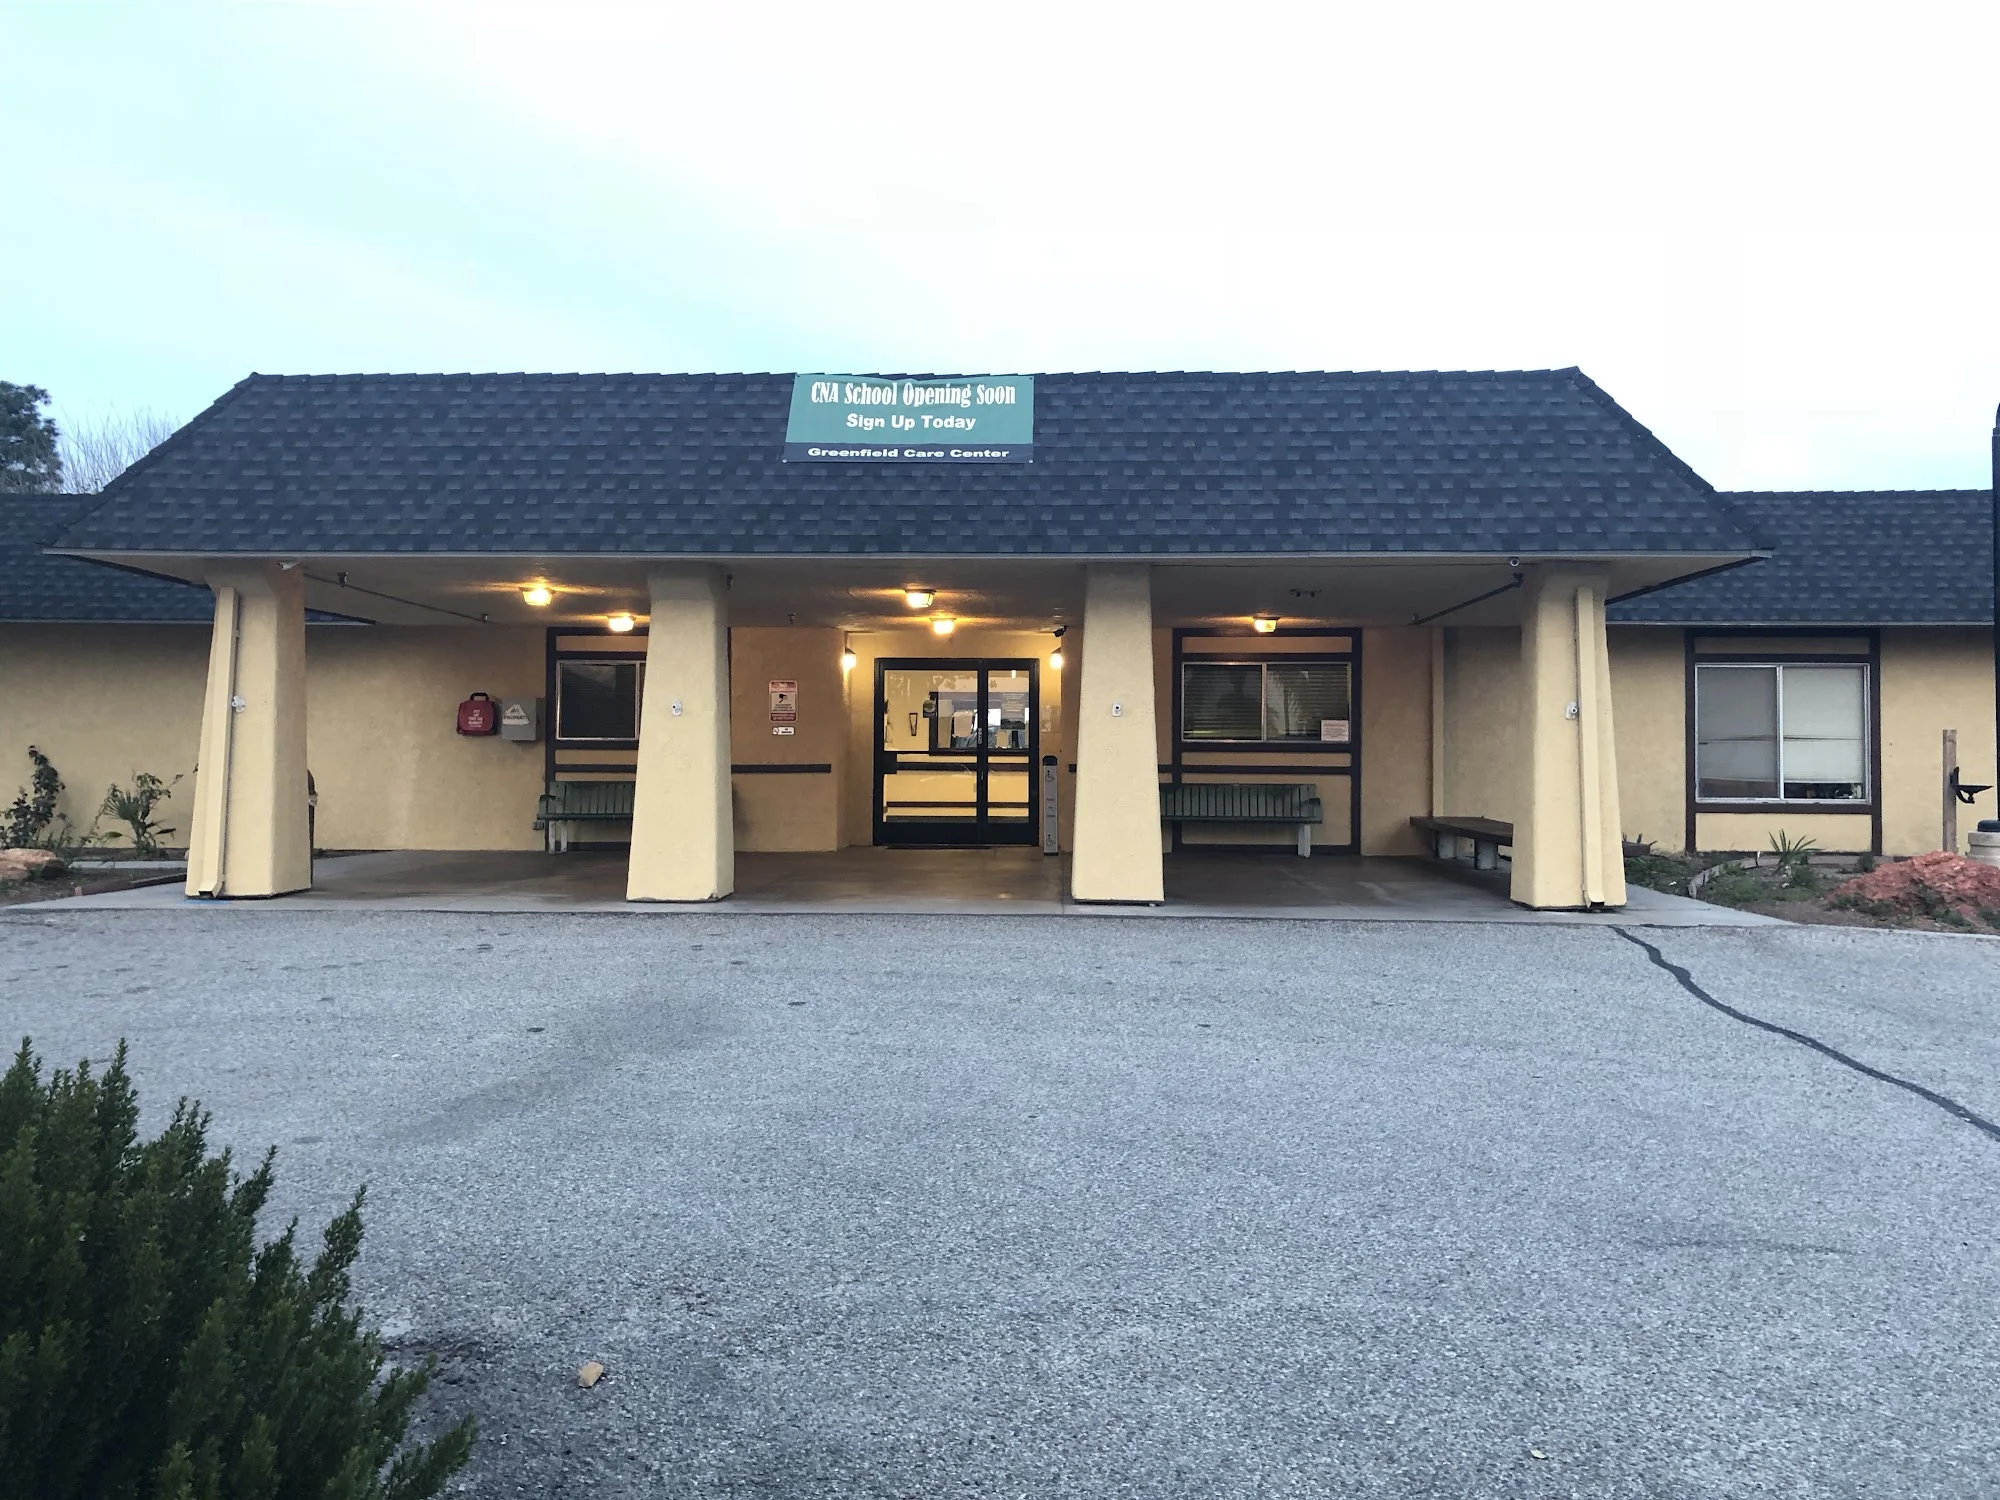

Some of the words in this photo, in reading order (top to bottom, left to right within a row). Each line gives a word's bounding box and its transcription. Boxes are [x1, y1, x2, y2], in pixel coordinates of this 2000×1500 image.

[811, 382, 839, 403] CNA
[844, 382, 898, 404] School
[903, 382, 972, 407] Opening
[977, 385, 1016, 405] Soon
[846, 413, 885, 430] Sign
[891, 415, 915, 431] Up
[921, 415, 976, 431] Today
[808, 448, 899, 457] Greenfield
[904, 449, 945, 458] Care
[950, 449, 1009, 458] Center
